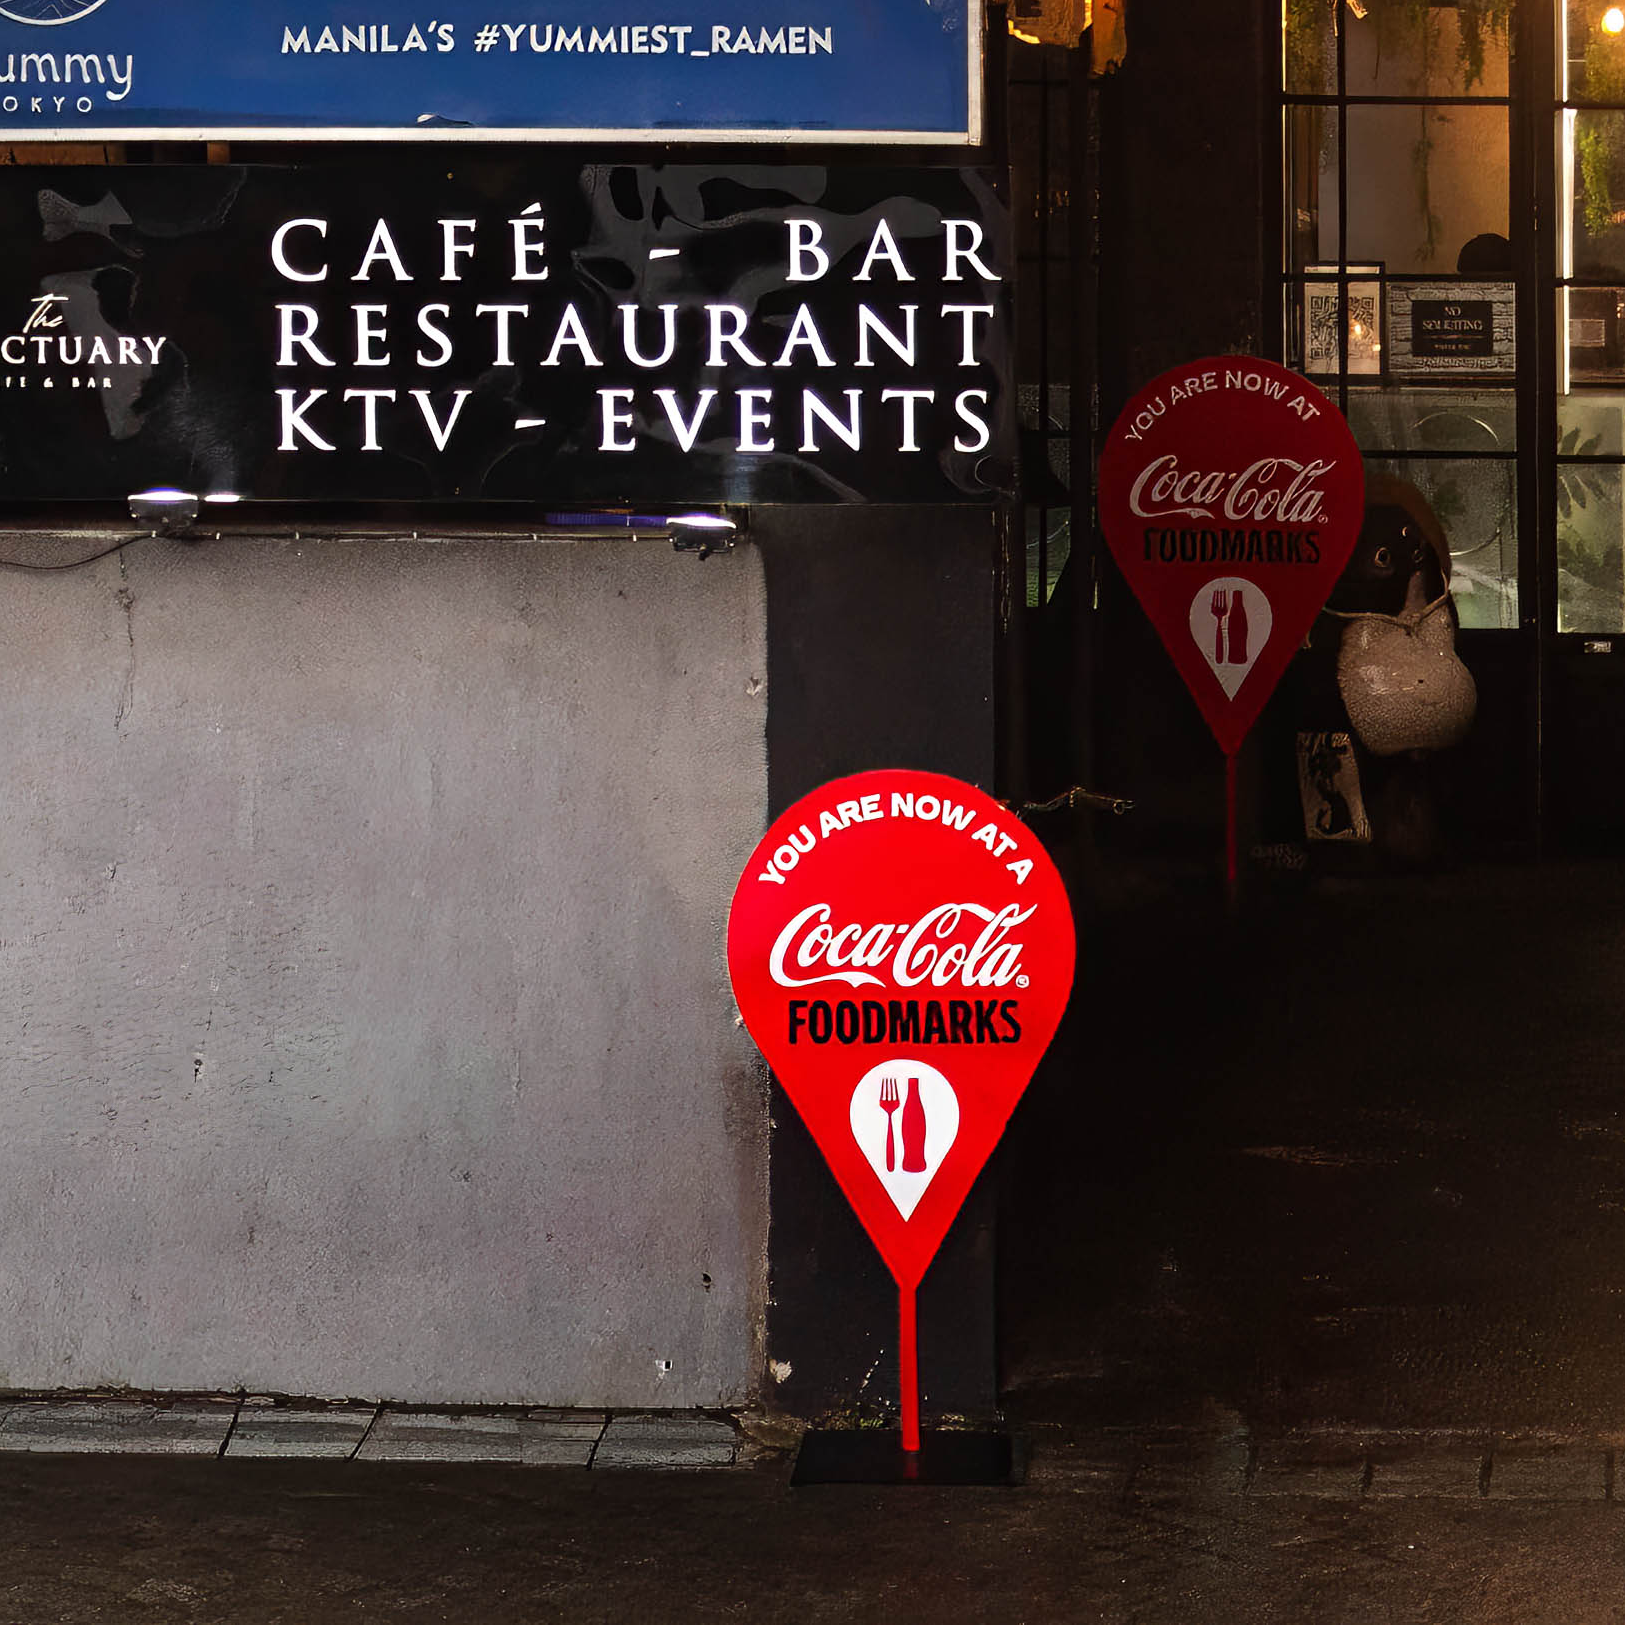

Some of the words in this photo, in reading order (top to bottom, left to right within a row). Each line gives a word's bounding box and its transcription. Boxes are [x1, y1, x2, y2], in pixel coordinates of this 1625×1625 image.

[282, 21, 455, 53] MANILA'S
[473, 24, 833, 56] #YUMMIEST_RAMEN
[273, 203, 548, 282] CAFÉ
[787, 219, 1001, 282] BAR
[23, 294, 69, 333] The
[275, 303, 995, 367] RESTAURANT
[43, 377, 53, 387] &
[71, 377, 111, 387] BAR
[1125, 397, 1165, 443] YOU
[1170, 372, 1220, 406] ARE
[1225, 370, 1291, 401] NOW
[1287, 393, 1320, 423] AT
[277, 388, 471, 450] KTV
[599, 388, 991, 452] EVENTS
[1143, 529, 1320, 565] FOODMARKS
[759, 826, 817, 886] YOU
[819, 794, 885, 839] ARE
[890, 792, 976, 831] NOW
[972, 823, 1018, 857] AT
[1006, 858, 1034, 884] A
[789, 1000, 1021, 1044] FOODMARKS
